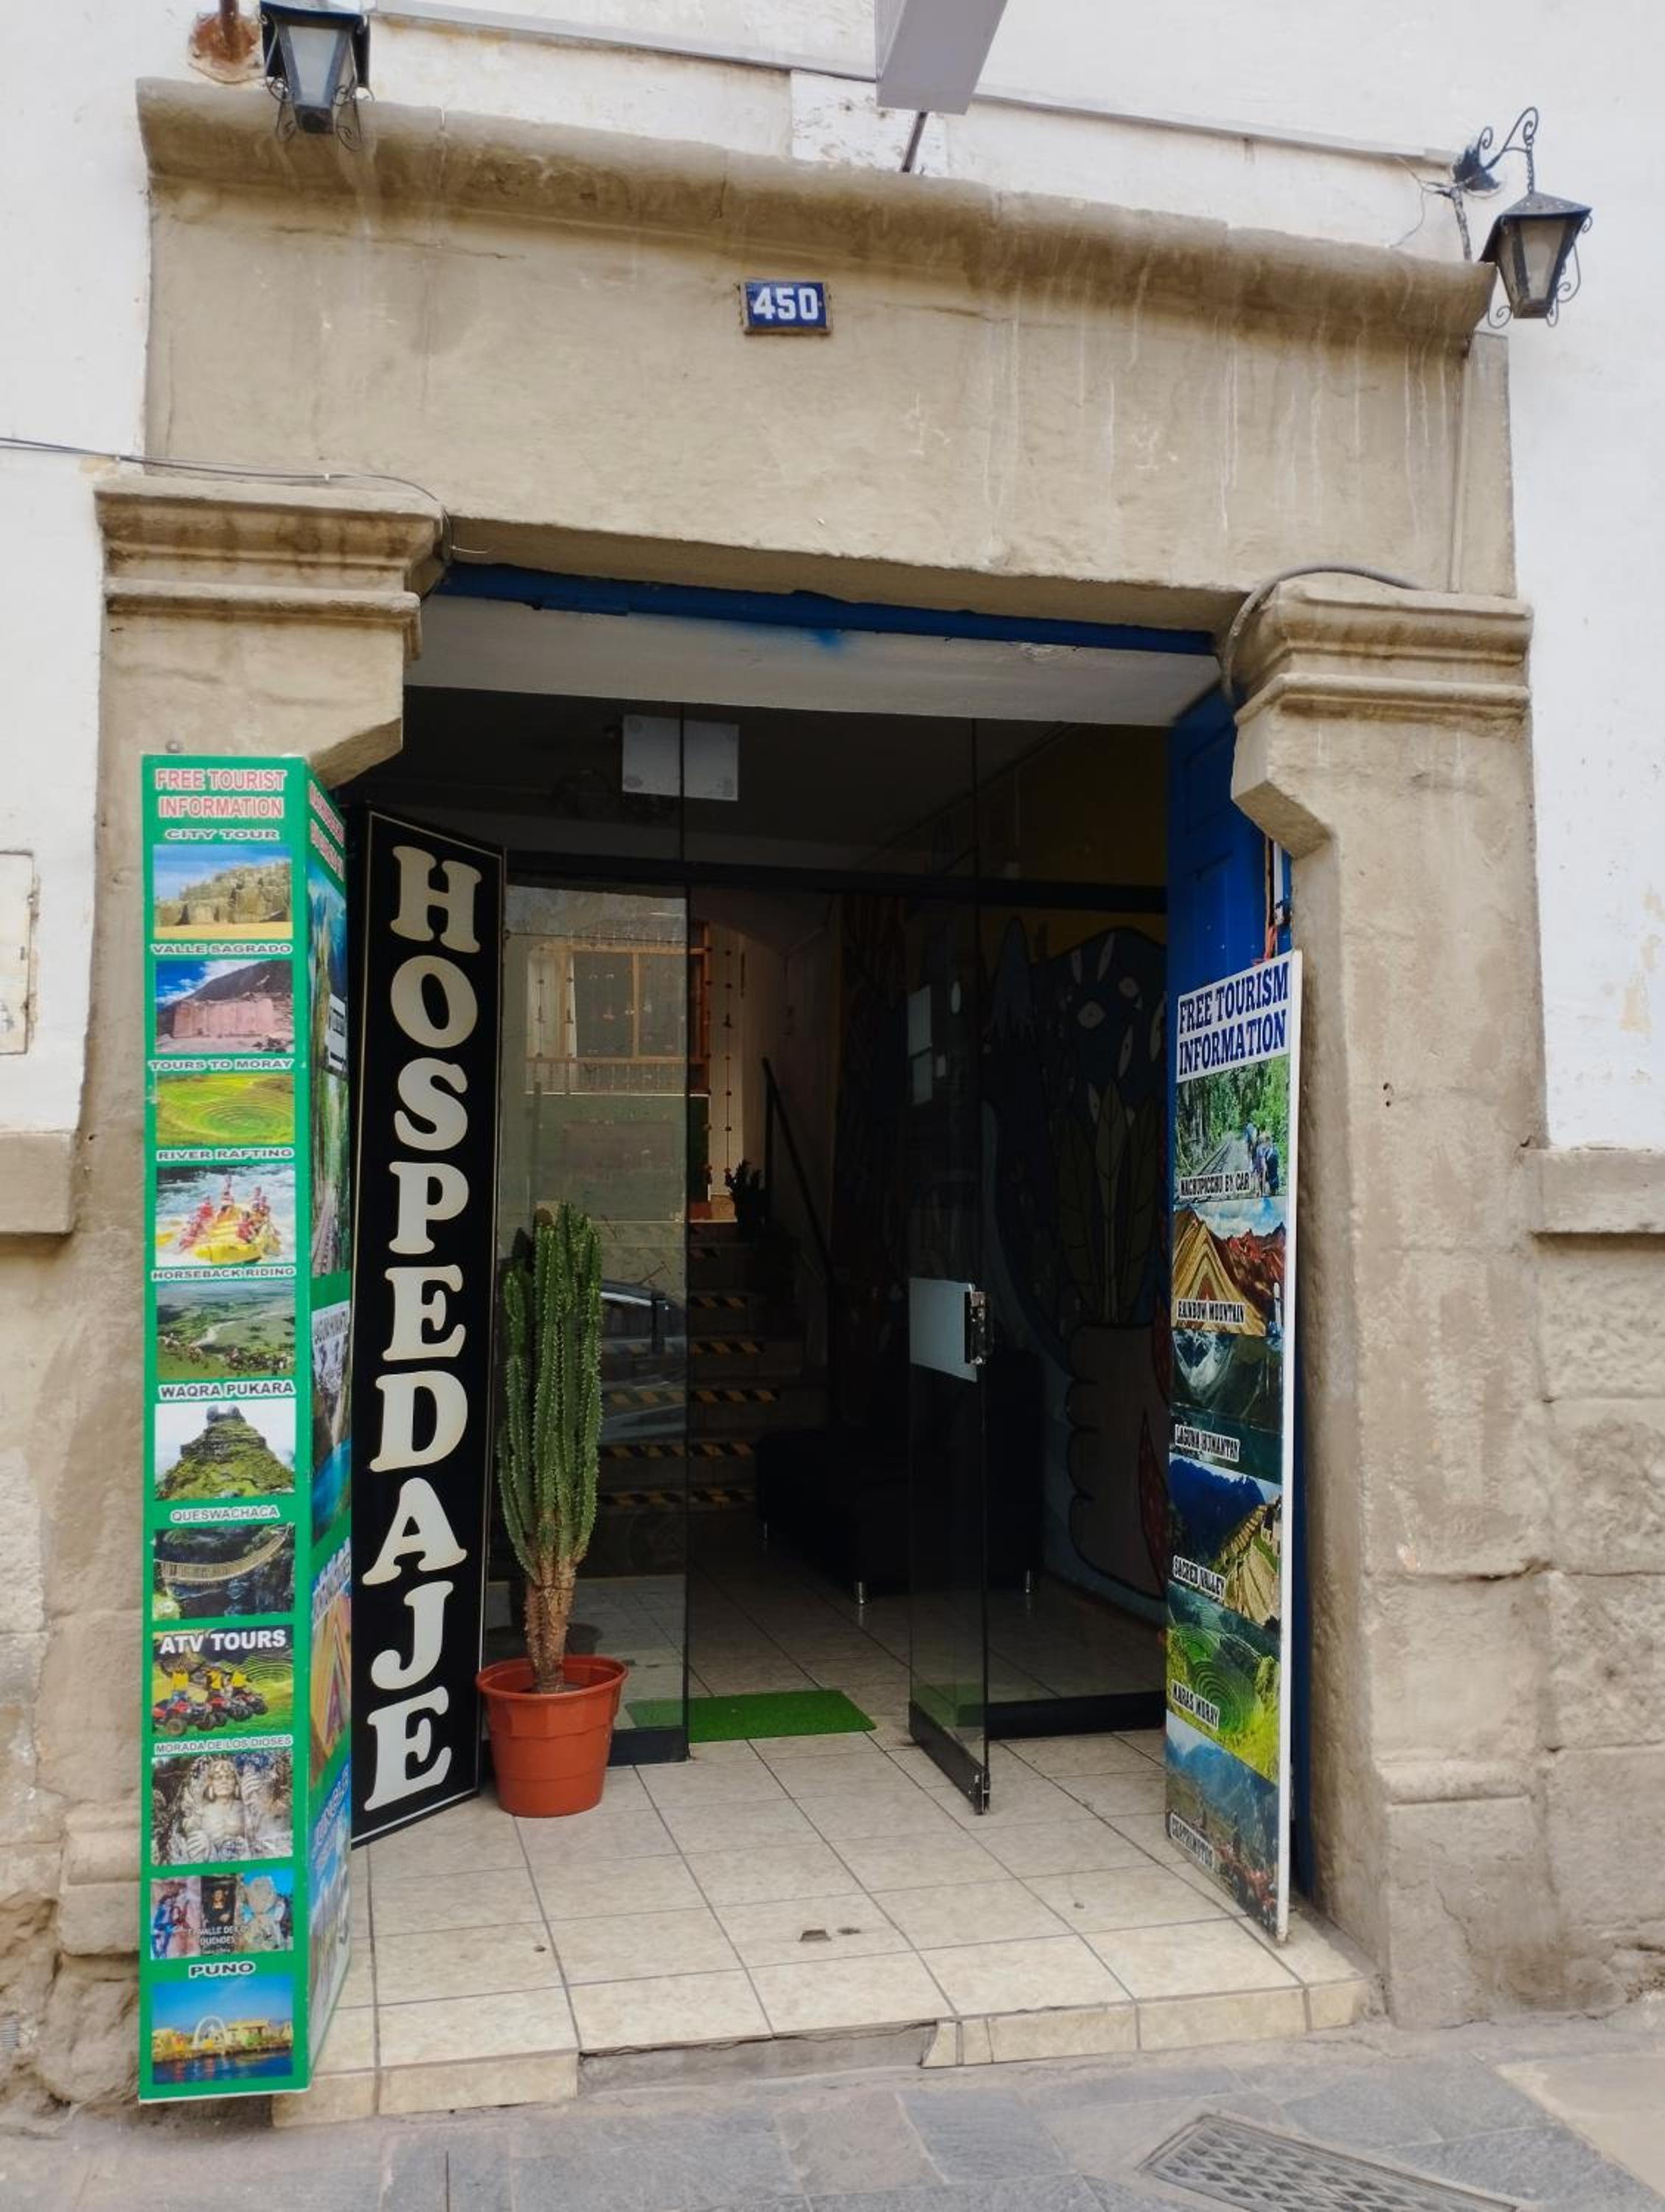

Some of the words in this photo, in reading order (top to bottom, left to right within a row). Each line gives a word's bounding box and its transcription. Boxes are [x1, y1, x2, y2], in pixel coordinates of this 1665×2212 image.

[753, 287, 818, 319] 450
[156, 768, 205, 790] FREE
[207, 769, 288, 790] TOURIST
[159, 796, 283, 818] INFORMATION
[166, 828, 217, 841] CITY
[220, 829, 279, 841] TOUR
[152, 944, 205, 955] VALLE
[211, 943, 293, 954] SAGRADO
[1180, 991, 1213, 1034] FREE
[1216, 961, 1289, 1022] TOURISM
[1179, 1009, 1287, 1076] INFORMATION
[150, 1060, 205, 1071] TOURS
[209, 1060, 231, 1070] TO
[235, 1060, 293, 1069] MORAY
[157, 1150, 213, 1161] RIVER
[217, 1148, 293, 1160] RAFTING
[152, 1268, 242, 1281] HORSEBACK
[245, 1266, 295, 1278] RIDING
[362, 845, 482, 1812] HOSPEDAJE
[160, 1383, 220, 1399] WAQRA
[226, 1380, 294, 1397] PUKARA
[170, 1506, 279, 1523] QUESWACHACA
[159, 1635, 204, 1655] ATV
[211, 1630, 287, 1652] TOURS
[156, 1741, 206, 1755] MORADA
[207, 1739, 223, 1750] DE
[225, 1737, 249, 1749] LOS
[251, 1735, 293, 1747] DIOSES
[190, 1961, 256, 1978] PUNO
